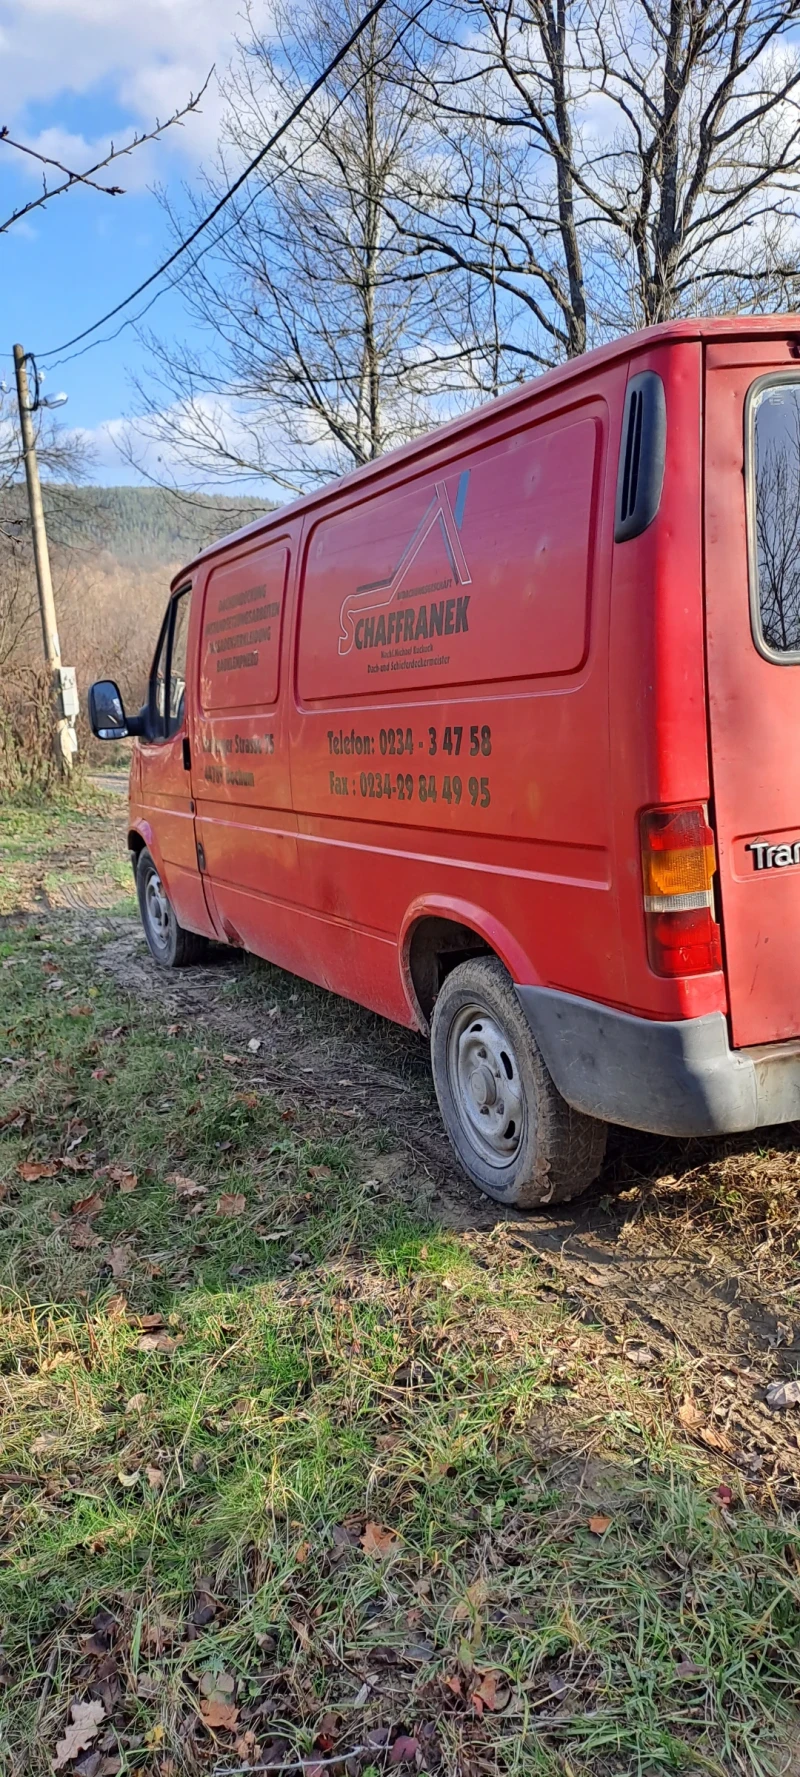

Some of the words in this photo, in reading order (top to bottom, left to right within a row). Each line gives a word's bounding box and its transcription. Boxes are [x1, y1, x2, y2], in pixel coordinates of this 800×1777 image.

[338, 594, 471, 656] SCHAFFRANEK
[327, 729, 375, 755] Telefon:
[379, 727, 414, 755] 0234
[428, 726, 437, 756] 3
[443, 726, 463, 756] 47
[470, 725, 492, 757] 58
[329, 771, 349, 795] Fax
[360, 772, 414, 801] 0234-29
[418, 774, 437, 803] 84
[442, 775, 462, 805] 49
[468, 776, 491, 808] 95
